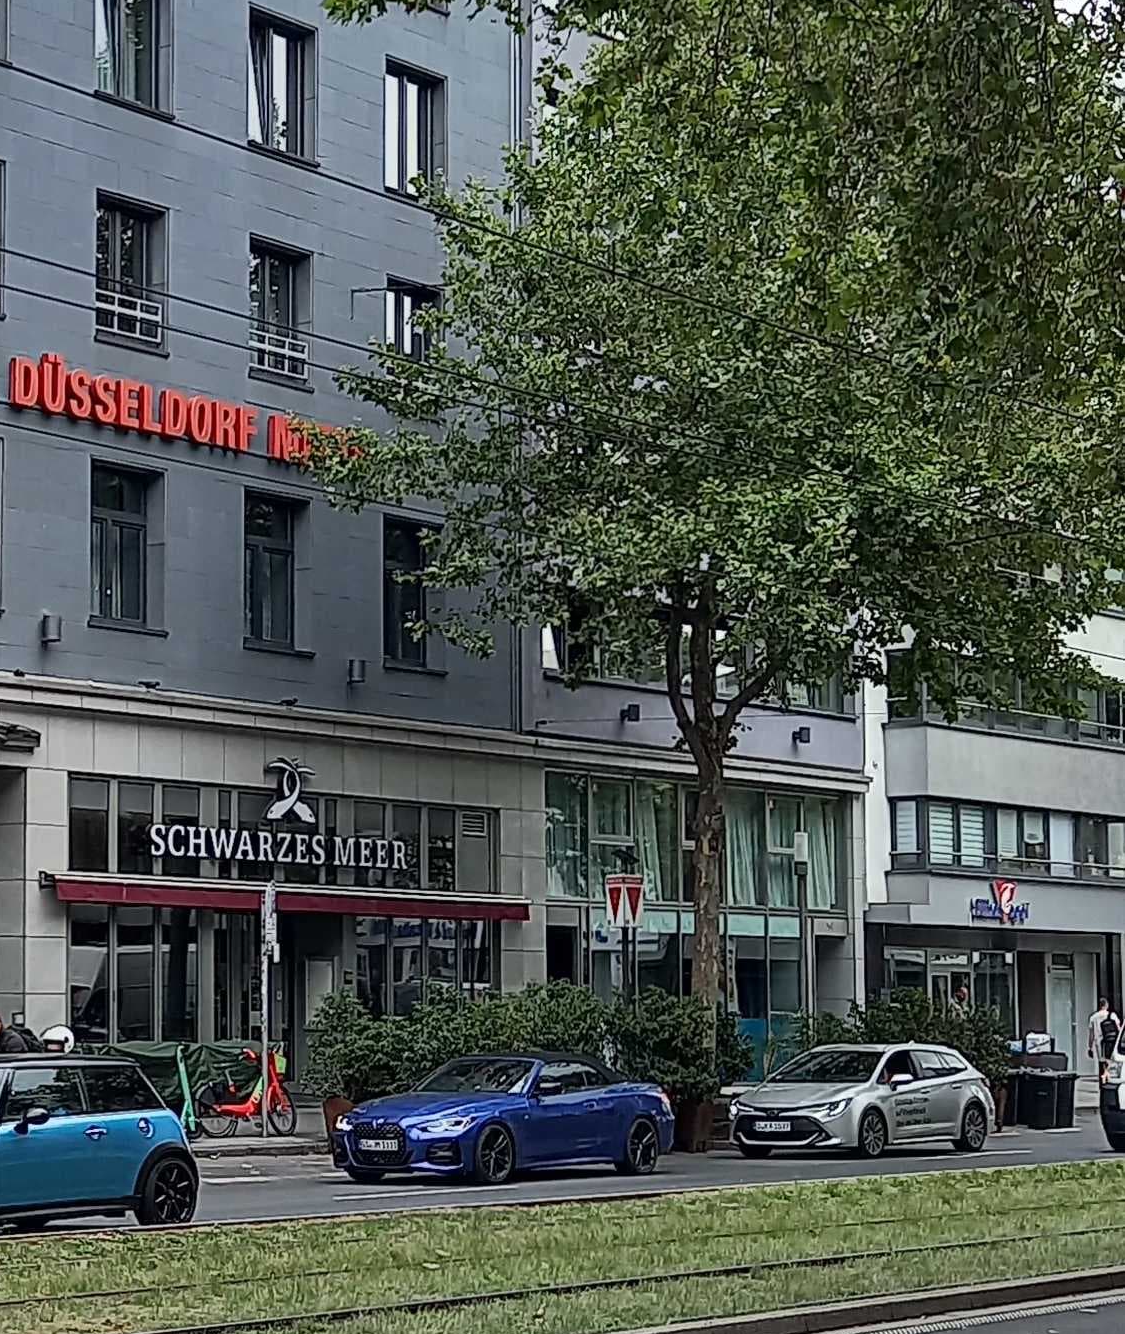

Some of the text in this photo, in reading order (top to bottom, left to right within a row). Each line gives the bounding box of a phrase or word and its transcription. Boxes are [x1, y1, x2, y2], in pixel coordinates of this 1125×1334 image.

[10, 353, 259, 452] DÜSSELDORF
[149, 824, 408, 870] SCHWARZES MEER
